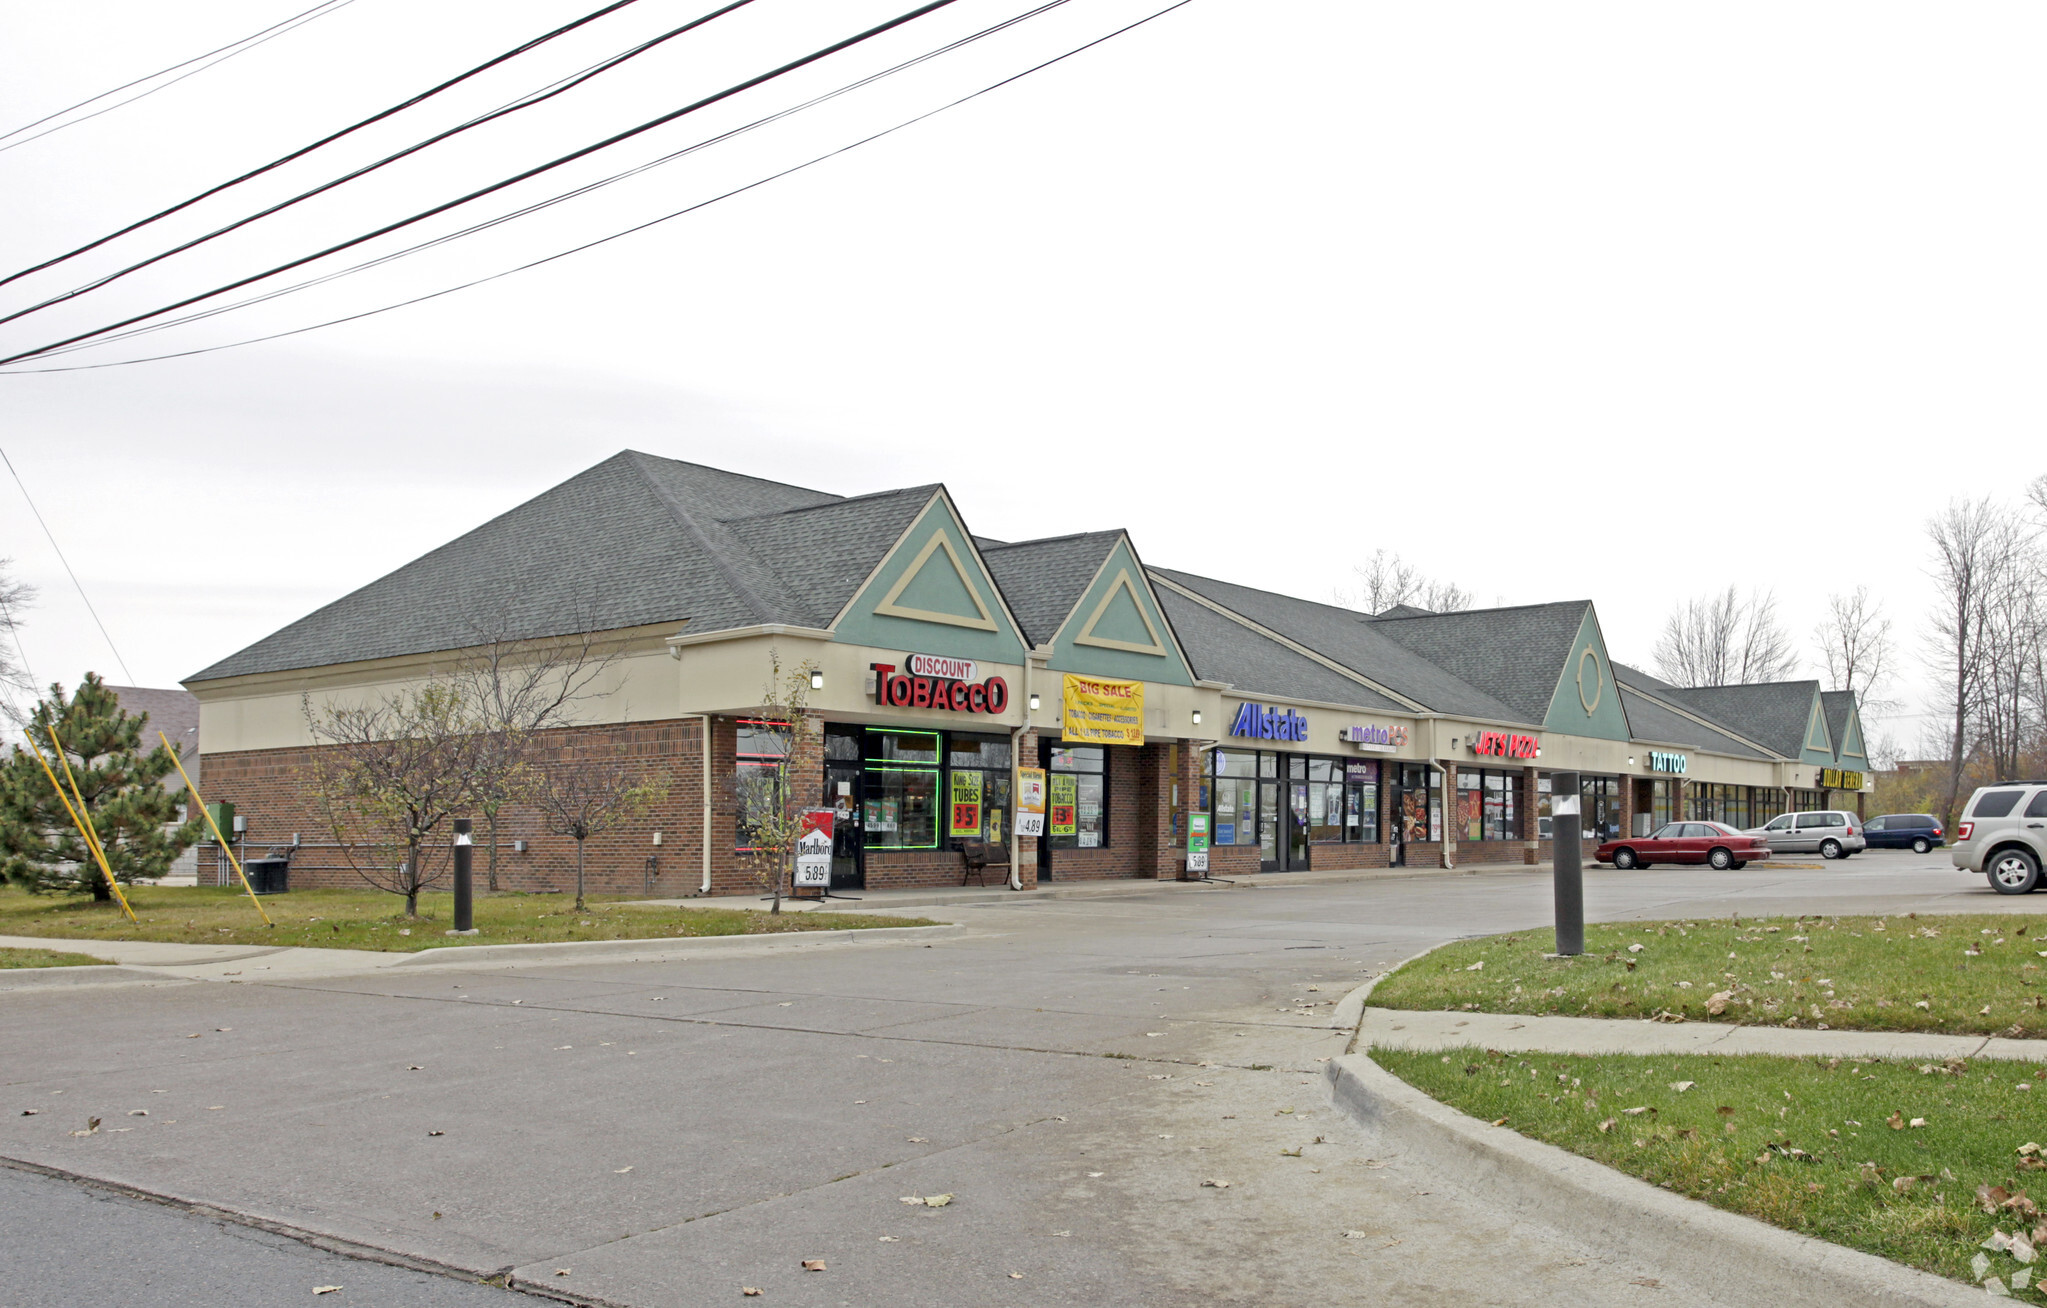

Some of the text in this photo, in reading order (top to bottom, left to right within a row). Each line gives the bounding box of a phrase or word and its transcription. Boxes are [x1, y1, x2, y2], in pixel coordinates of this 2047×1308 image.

[915, 656, 972, 679] DISCOUNT
[1080, 681, 1132, 698] BIG SALE
[1233, 702, 1308, 742] Allstate
[1068, 726, 1079, 736] ALL
[1102, 729, 1124, 740] TOBACCO
[1351, 724, 1409, 747] metroPCS
[1508, 734, 1539, 759] PIZZA
[1346, 763, 1367, 774] metro
[1652, 751, 1687, 774] TATTOO
[953, 787, 979, 802] TUBES
[1052, 793, 1073, 804] TOBACCO
[1217, 805, 1235, 813] Allstate
[1025, 819, 1041, 833] 4.89
[805, 865, 825, 881] 5.89
